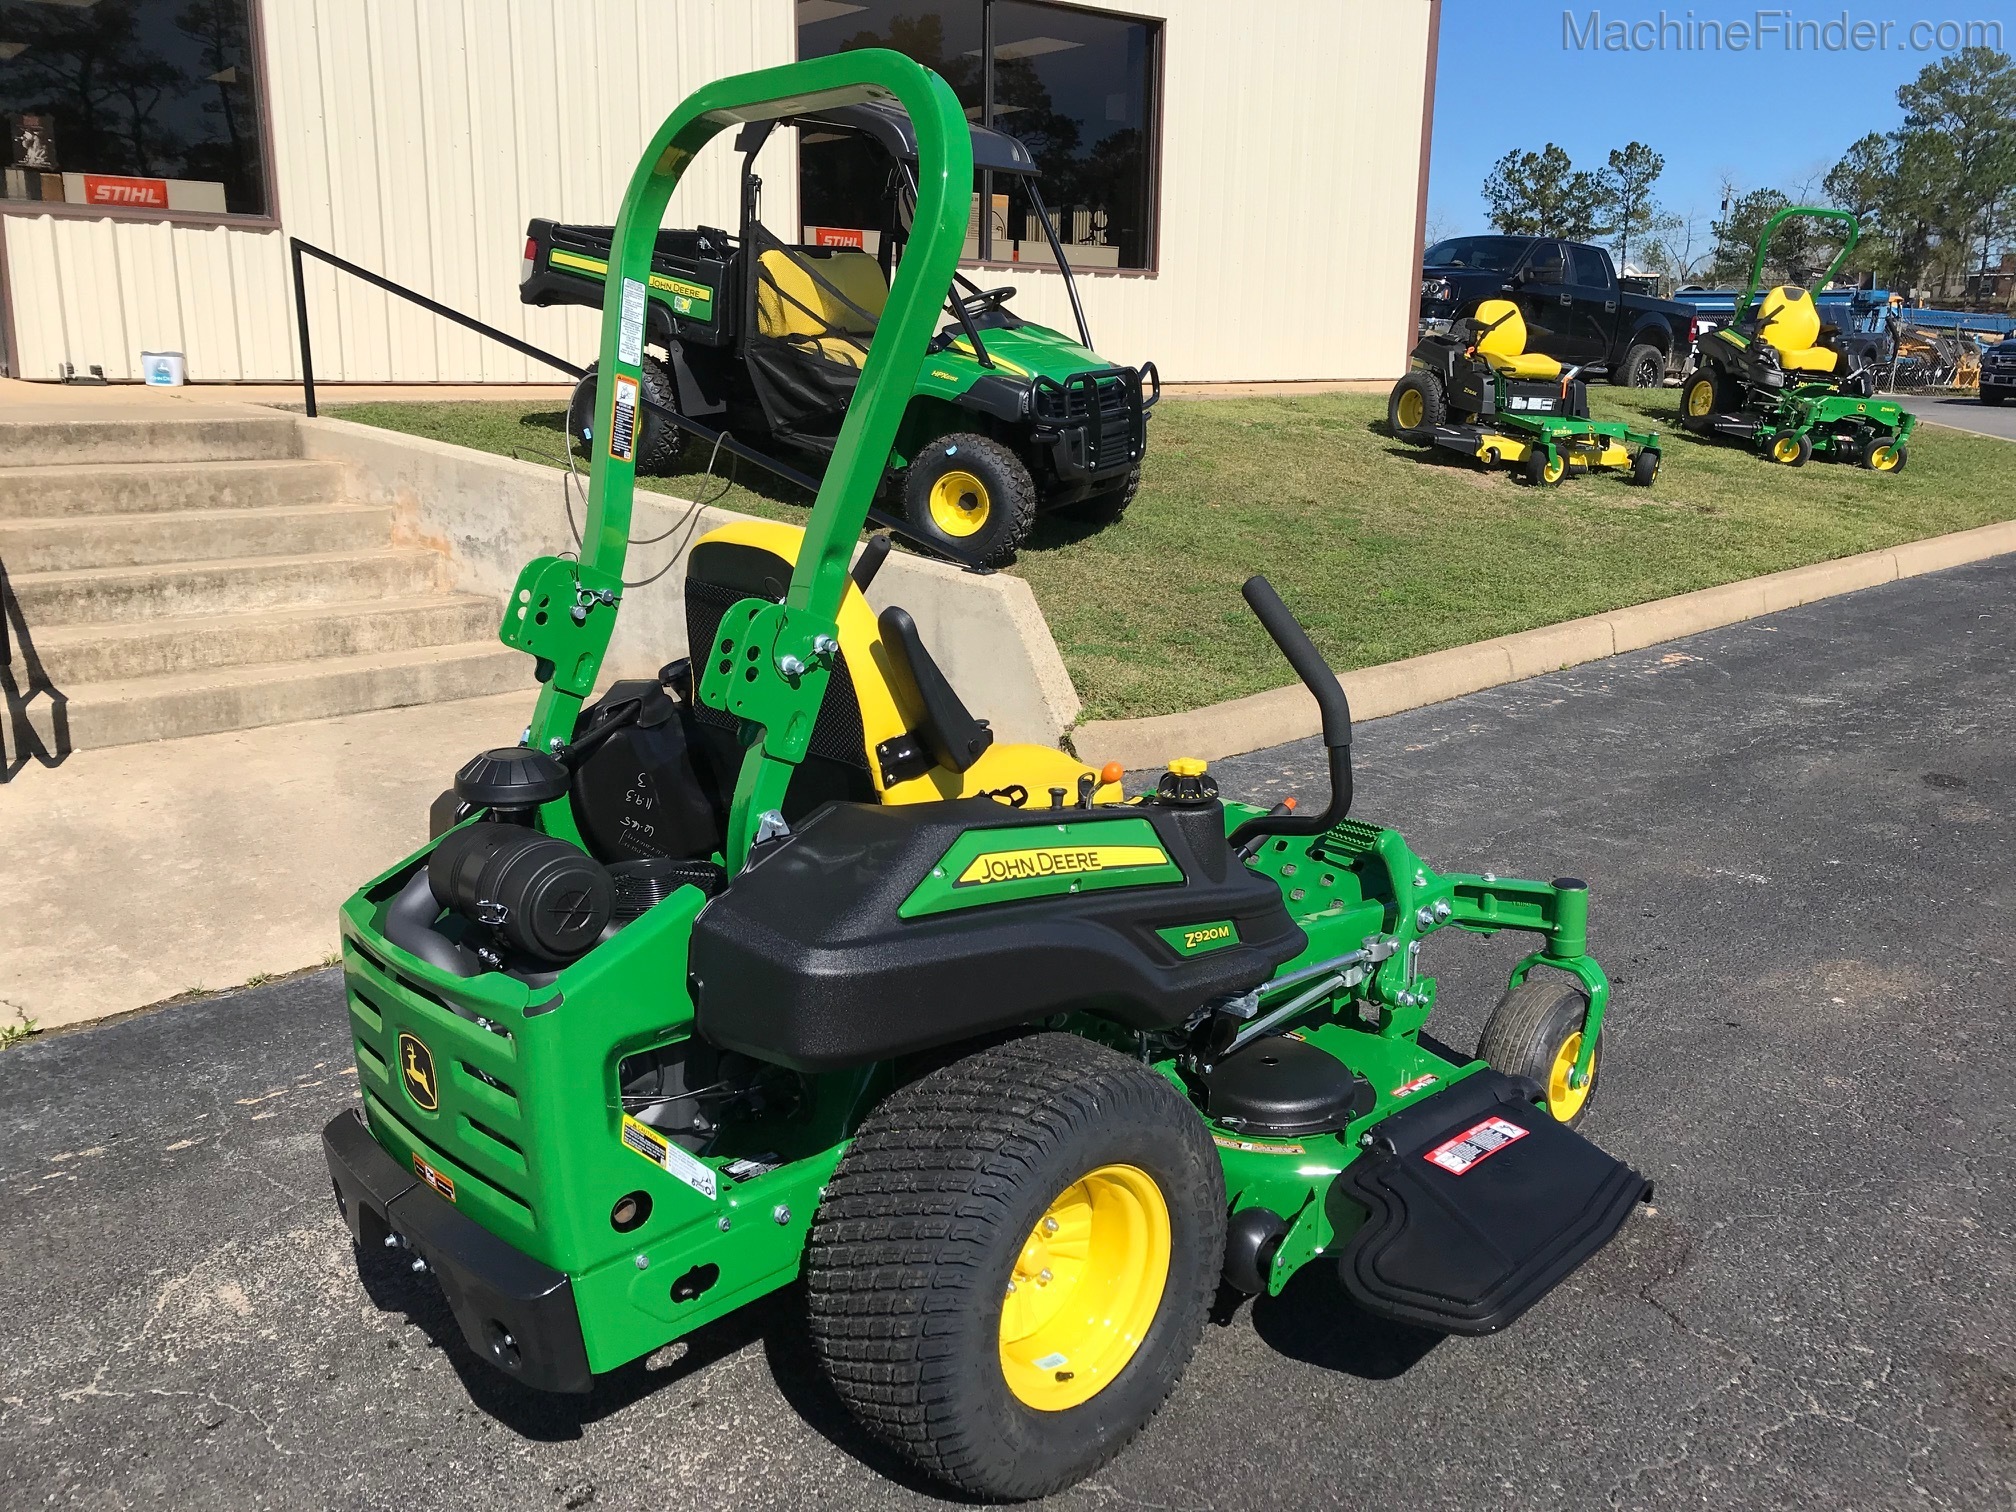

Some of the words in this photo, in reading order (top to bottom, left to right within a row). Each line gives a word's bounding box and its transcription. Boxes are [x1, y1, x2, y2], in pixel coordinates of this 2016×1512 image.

[94, 184, 161, 203] STIHL
[823, 235, 861, 248] STIHL
[649, 278, 672, 291] JOHN
[673, 284, 701, 298] DEERE
[637, 772, 647, 788] 3
[981, 857, 1036, 880] JOHN
[1036, 851, 1102, 872] DEERE
[1184, 925, 1231, 949] Z920M
